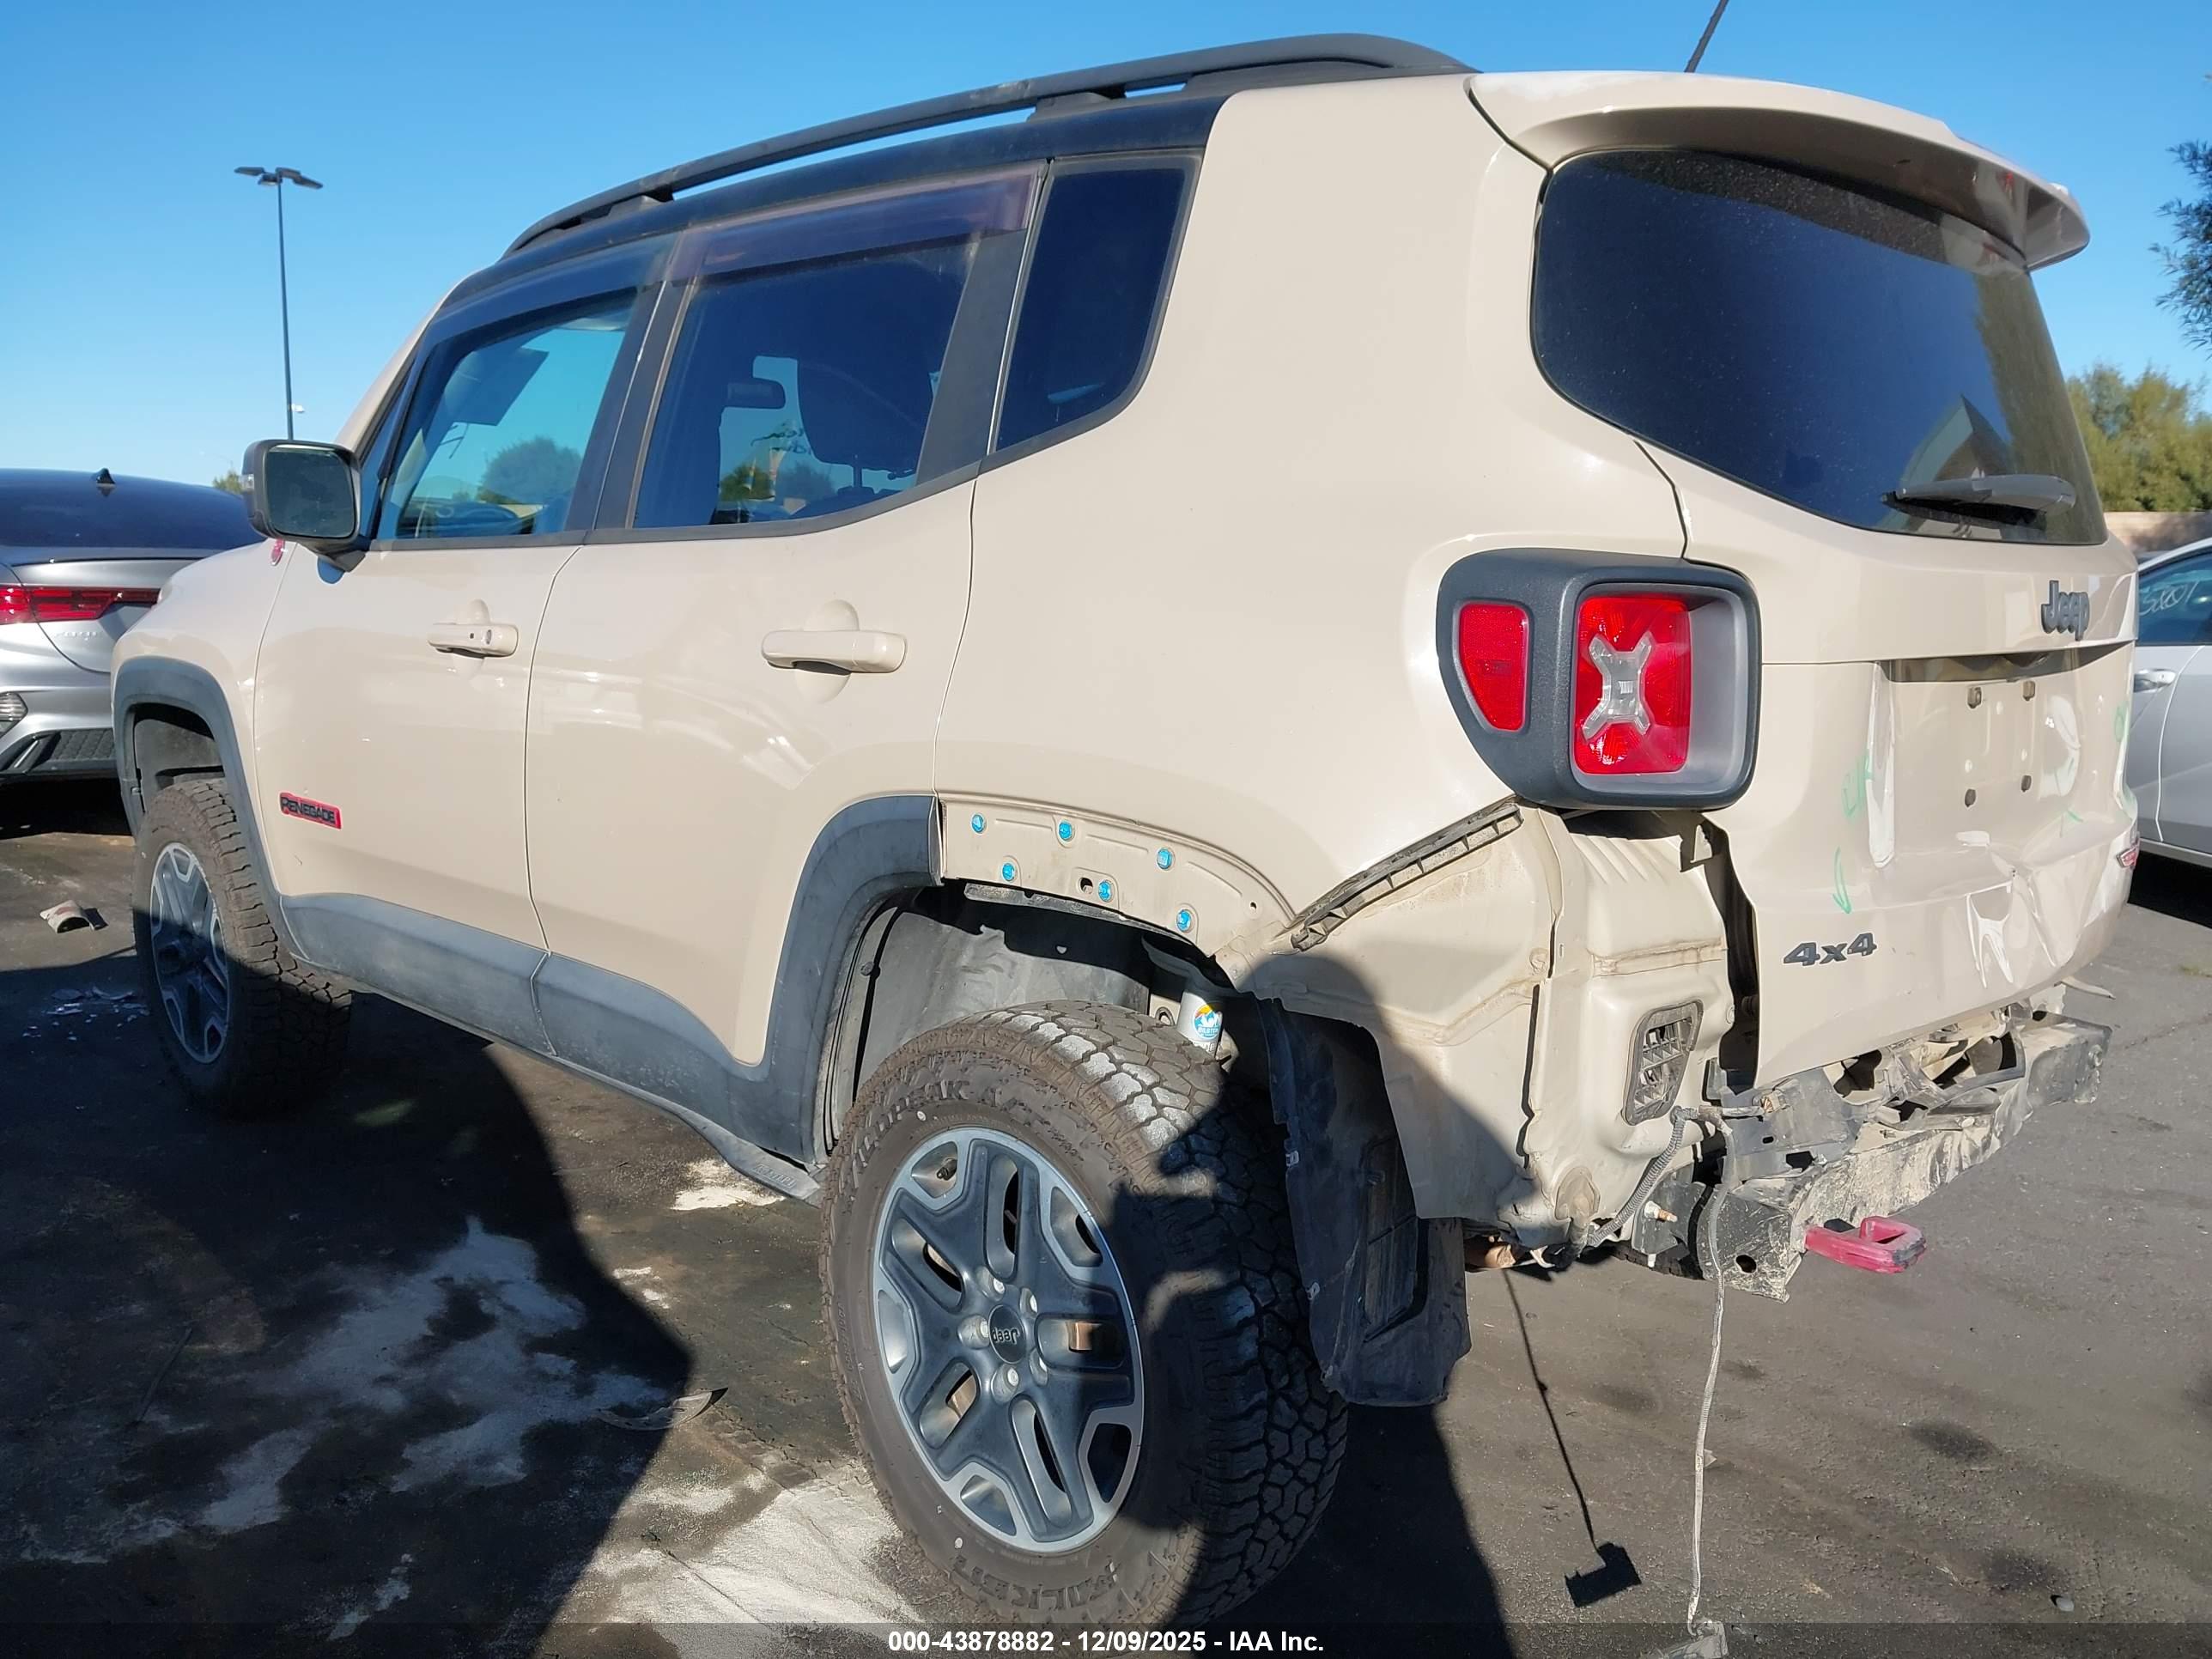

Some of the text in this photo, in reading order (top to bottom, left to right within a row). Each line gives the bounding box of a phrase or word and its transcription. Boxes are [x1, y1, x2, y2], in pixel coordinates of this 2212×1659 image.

[2040, 580, 2090, 641] Jeep
[280, 796, 336, 824] RENEGADE
[1783, 933, 1878, 967] 4x4
[992, 1327, 1020, 1346] Jeep
[951, 1555, 1118, 1613] FALKEN
